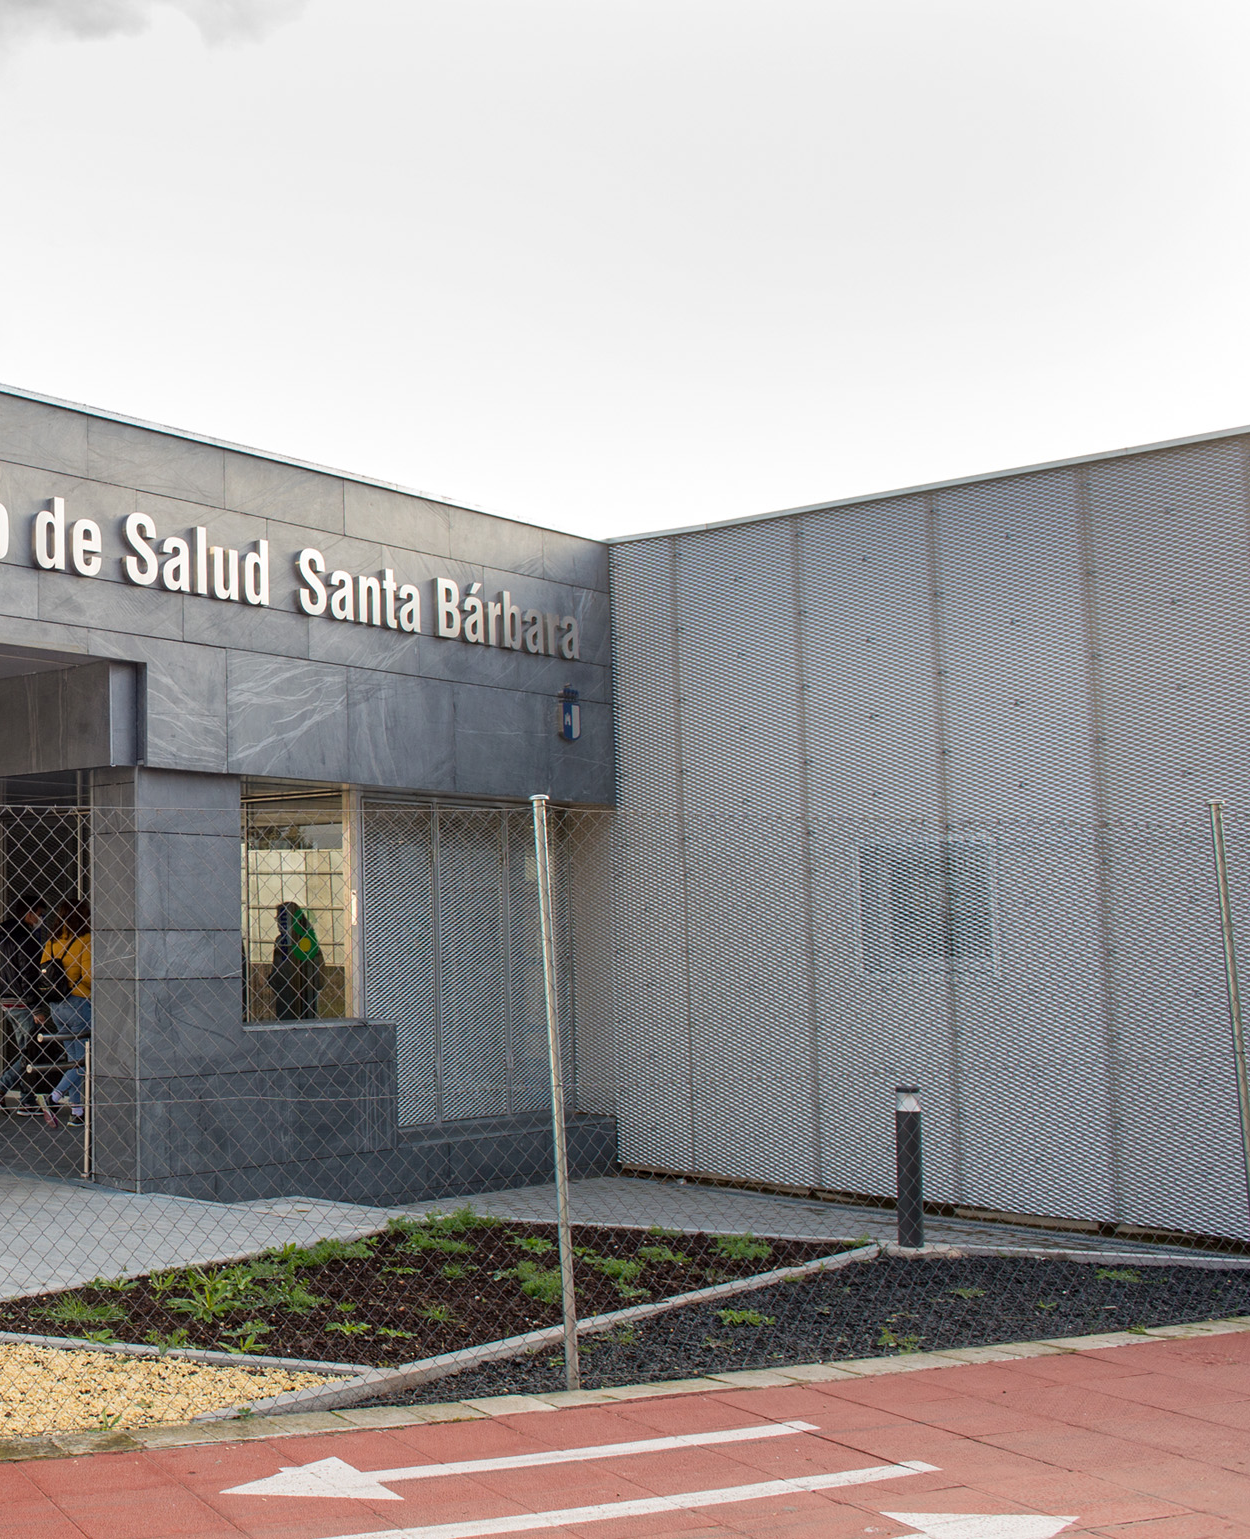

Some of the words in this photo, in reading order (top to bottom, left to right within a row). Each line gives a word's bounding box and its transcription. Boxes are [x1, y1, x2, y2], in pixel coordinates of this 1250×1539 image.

[32, 497, 103, 577] de
[123, 512, 269, 607] Salud
[297, 547, 422, 633] Santa
[434, 577, 580, 660] Bárbara
